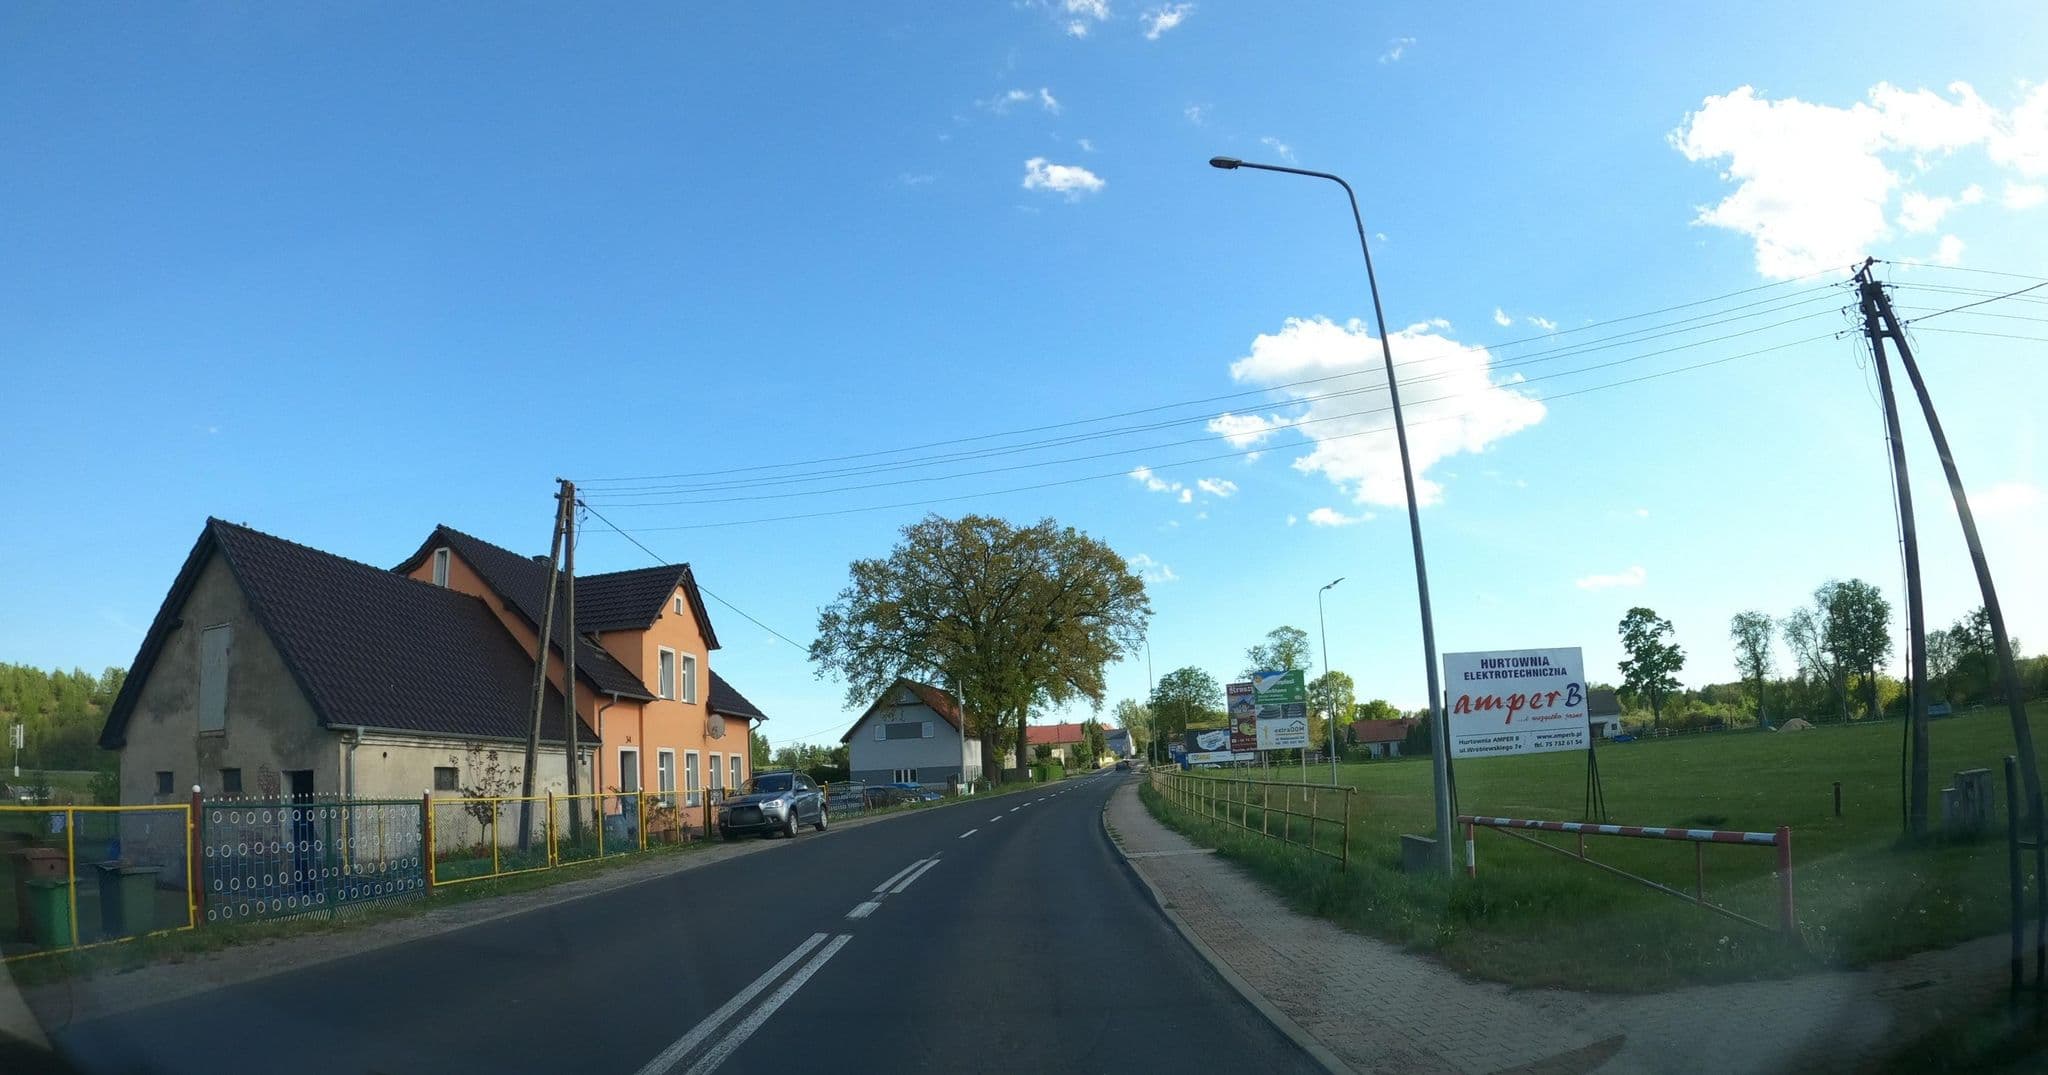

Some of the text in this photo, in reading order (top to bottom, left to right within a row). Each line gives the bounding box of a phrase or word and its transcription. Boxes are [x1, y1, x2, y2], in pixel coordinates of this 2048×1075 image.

[1480, 656, 1551, 669] HURTOWNIA
[1464, 667, 1568, 681] ELEKTROTECHNICZNA
[1453, 682, 1583, 725] amper B
